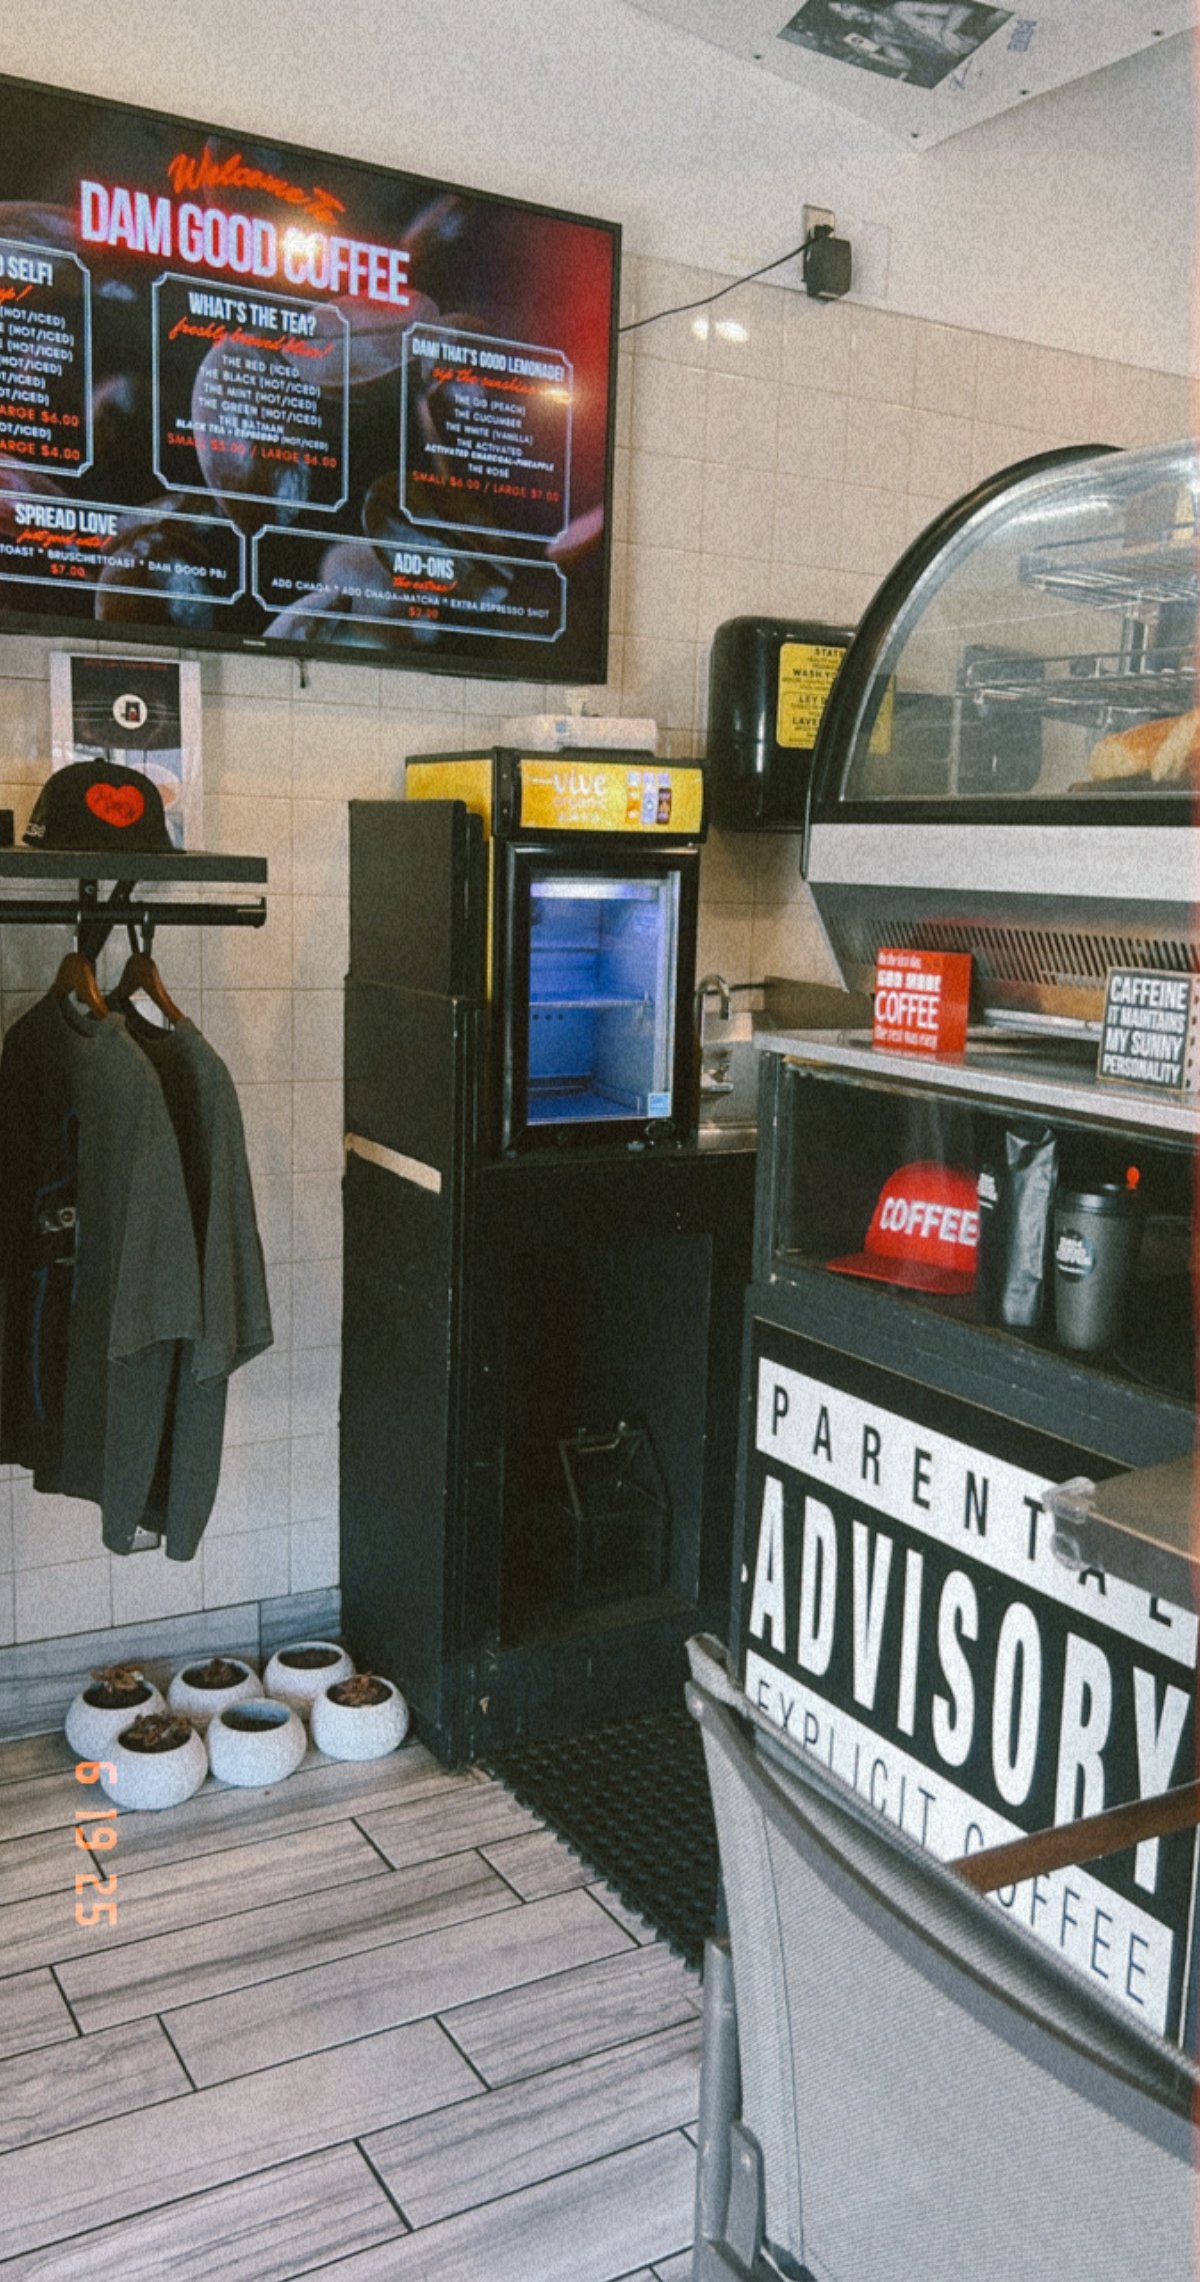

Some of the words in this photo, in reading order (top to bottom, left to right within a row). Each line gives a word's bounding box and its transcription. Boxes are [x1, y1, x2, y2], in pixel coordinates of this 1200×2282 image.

[168, 147, 311, 204] Welcome
[80, 179, 172, 258] DAM
[178, 202, 277, 278] GOOD
[283, 226, 411, 307] COFFEE
[7, 255, 53, 287] SELF!
[188, 291, 247, 323] WHAT'S
[249, 304, 278, 329] THE
[280, 309, 317, 336] TEA?
[9, 324, 75, 347] (HOT/ICED)
[7, 341, 73, 363] (HOT/ICED)
[221, 354, 241, 369] THE
[245, 359, 267, 373] RED
[442, 343, 479, 366] THAT'S
[480, 351, 507, 371] GOOD
[200, 367, 219, 380] THE
[223, 370, 257, 386] BLACK
[259, 379, 321, 399] (HOT/ICED)
[203, 382, 223, 396] THE
[227, 387, 252, 399] MINT
[255, 389, 318, 412] (HOT/ICED)
[41, 410, 80, 428] $6.00
[199, 397, 218, 410] THE
[221, 400, 259, 416] GREEN
[261, 406, 323, 428] (HOT/ICED)
[454, 393, 470, 406] THE
[473, 398, 488, 409] OG
[491, 400, 527, 417] (PEACH)
[454, 408, 470, 420] THE
[473, 412, 523, 429] CUCUMBER
[175, 418, 206, 432] BLACK
[209, 423, 225, 434] TEA
[219, 415, 239, 429] THE
[242, 418, 285, 434] BATMAN
[446, 421, 461, 433] THE
[464, 425, 490, 438] WHITE
[492, 428, 533, 446] (VANILLA)
[41, 444, 81, 461] $4.00
[261, 447, 300, 463] LARGE
[303, 453, 337, 468] $6.00
[424, 443, 469, 458] ACTIVATED
[457, 438, 473, 450] THE
[475, 441, 523, 457] ACTIVATED
[468, 463, 483, 475] THE
[412, 470, 446, 486] SMALL
[493, 484, 527, 498] LARGE
[15, 503, 76, 530] SPREAD
[79, 510, 118, 536] LOVE
[47, 549, 136, 568] BRUSCHETTOAST
[148, 561, 172, 573] DAM
[174, 563, 207, 577] GOOD
[209, 567, 227, 580] PBJ
[50, 563, 86, 578] $7.00
[393, 552, 455, 580] ADD-ONS
[271, 577, 292, 588] ADD
[295, 579, 332, 593] CHAGA
[342, 585, 362, 597] ADD
[450, 598, 478, 611] EXTRA
[480, 602, 525, 617] ESPRESSO
[527, 607, 550, 619] SHOT
[792, 668, 823, 678] WASH
[1109, 975, 1189, 1010] CAFFEINE
[874, 990, 941, 1031] COFFEE
[1107, 1005, 1120, 1026] IT
[1119, 1006, 1187, 1034] MAINTAINS
[1105, 1027, 1131, 1054] MY
[1130, 1030, 1184, 1062] SUNNY
[1102, 1053, 1182, 1084] PERSONALITY
[879, 1197, 981, 1248] COFFEE
[749, 1475, 1192, 1895] ADVISORY
[758, 1678, 936, 1848] EXPLICIT
